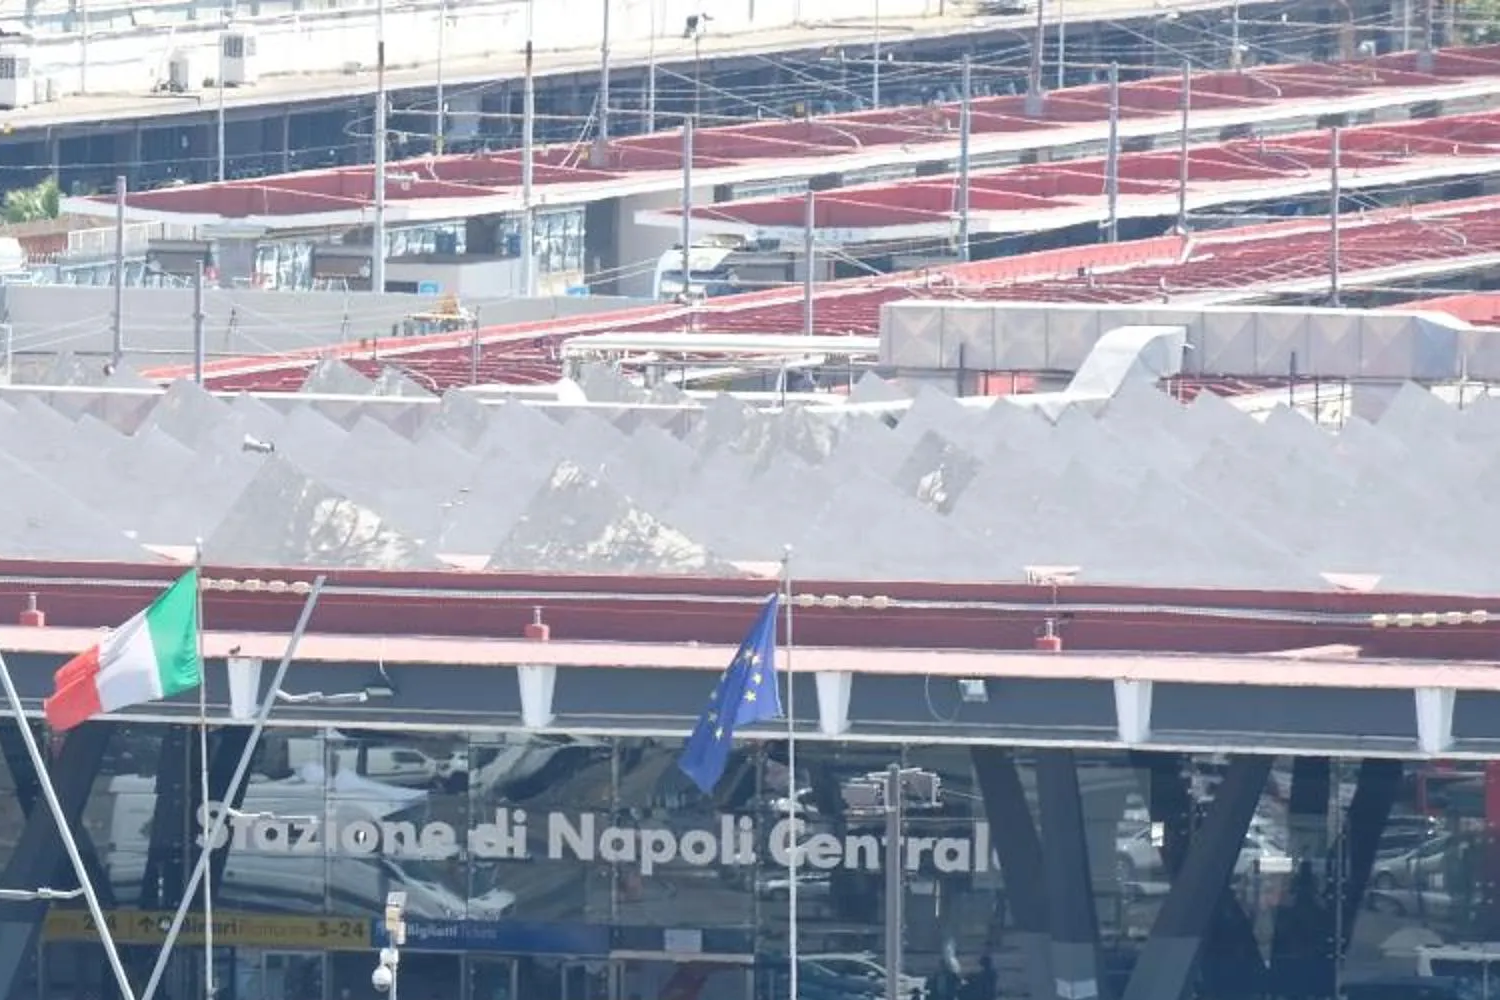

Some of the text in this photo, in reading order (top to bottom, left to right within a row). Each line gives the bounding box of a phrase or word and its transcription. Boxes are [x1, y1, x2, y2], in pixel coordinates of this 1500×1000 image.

[196, 801, 1002, 876] Stazione di Napoli Cenral
